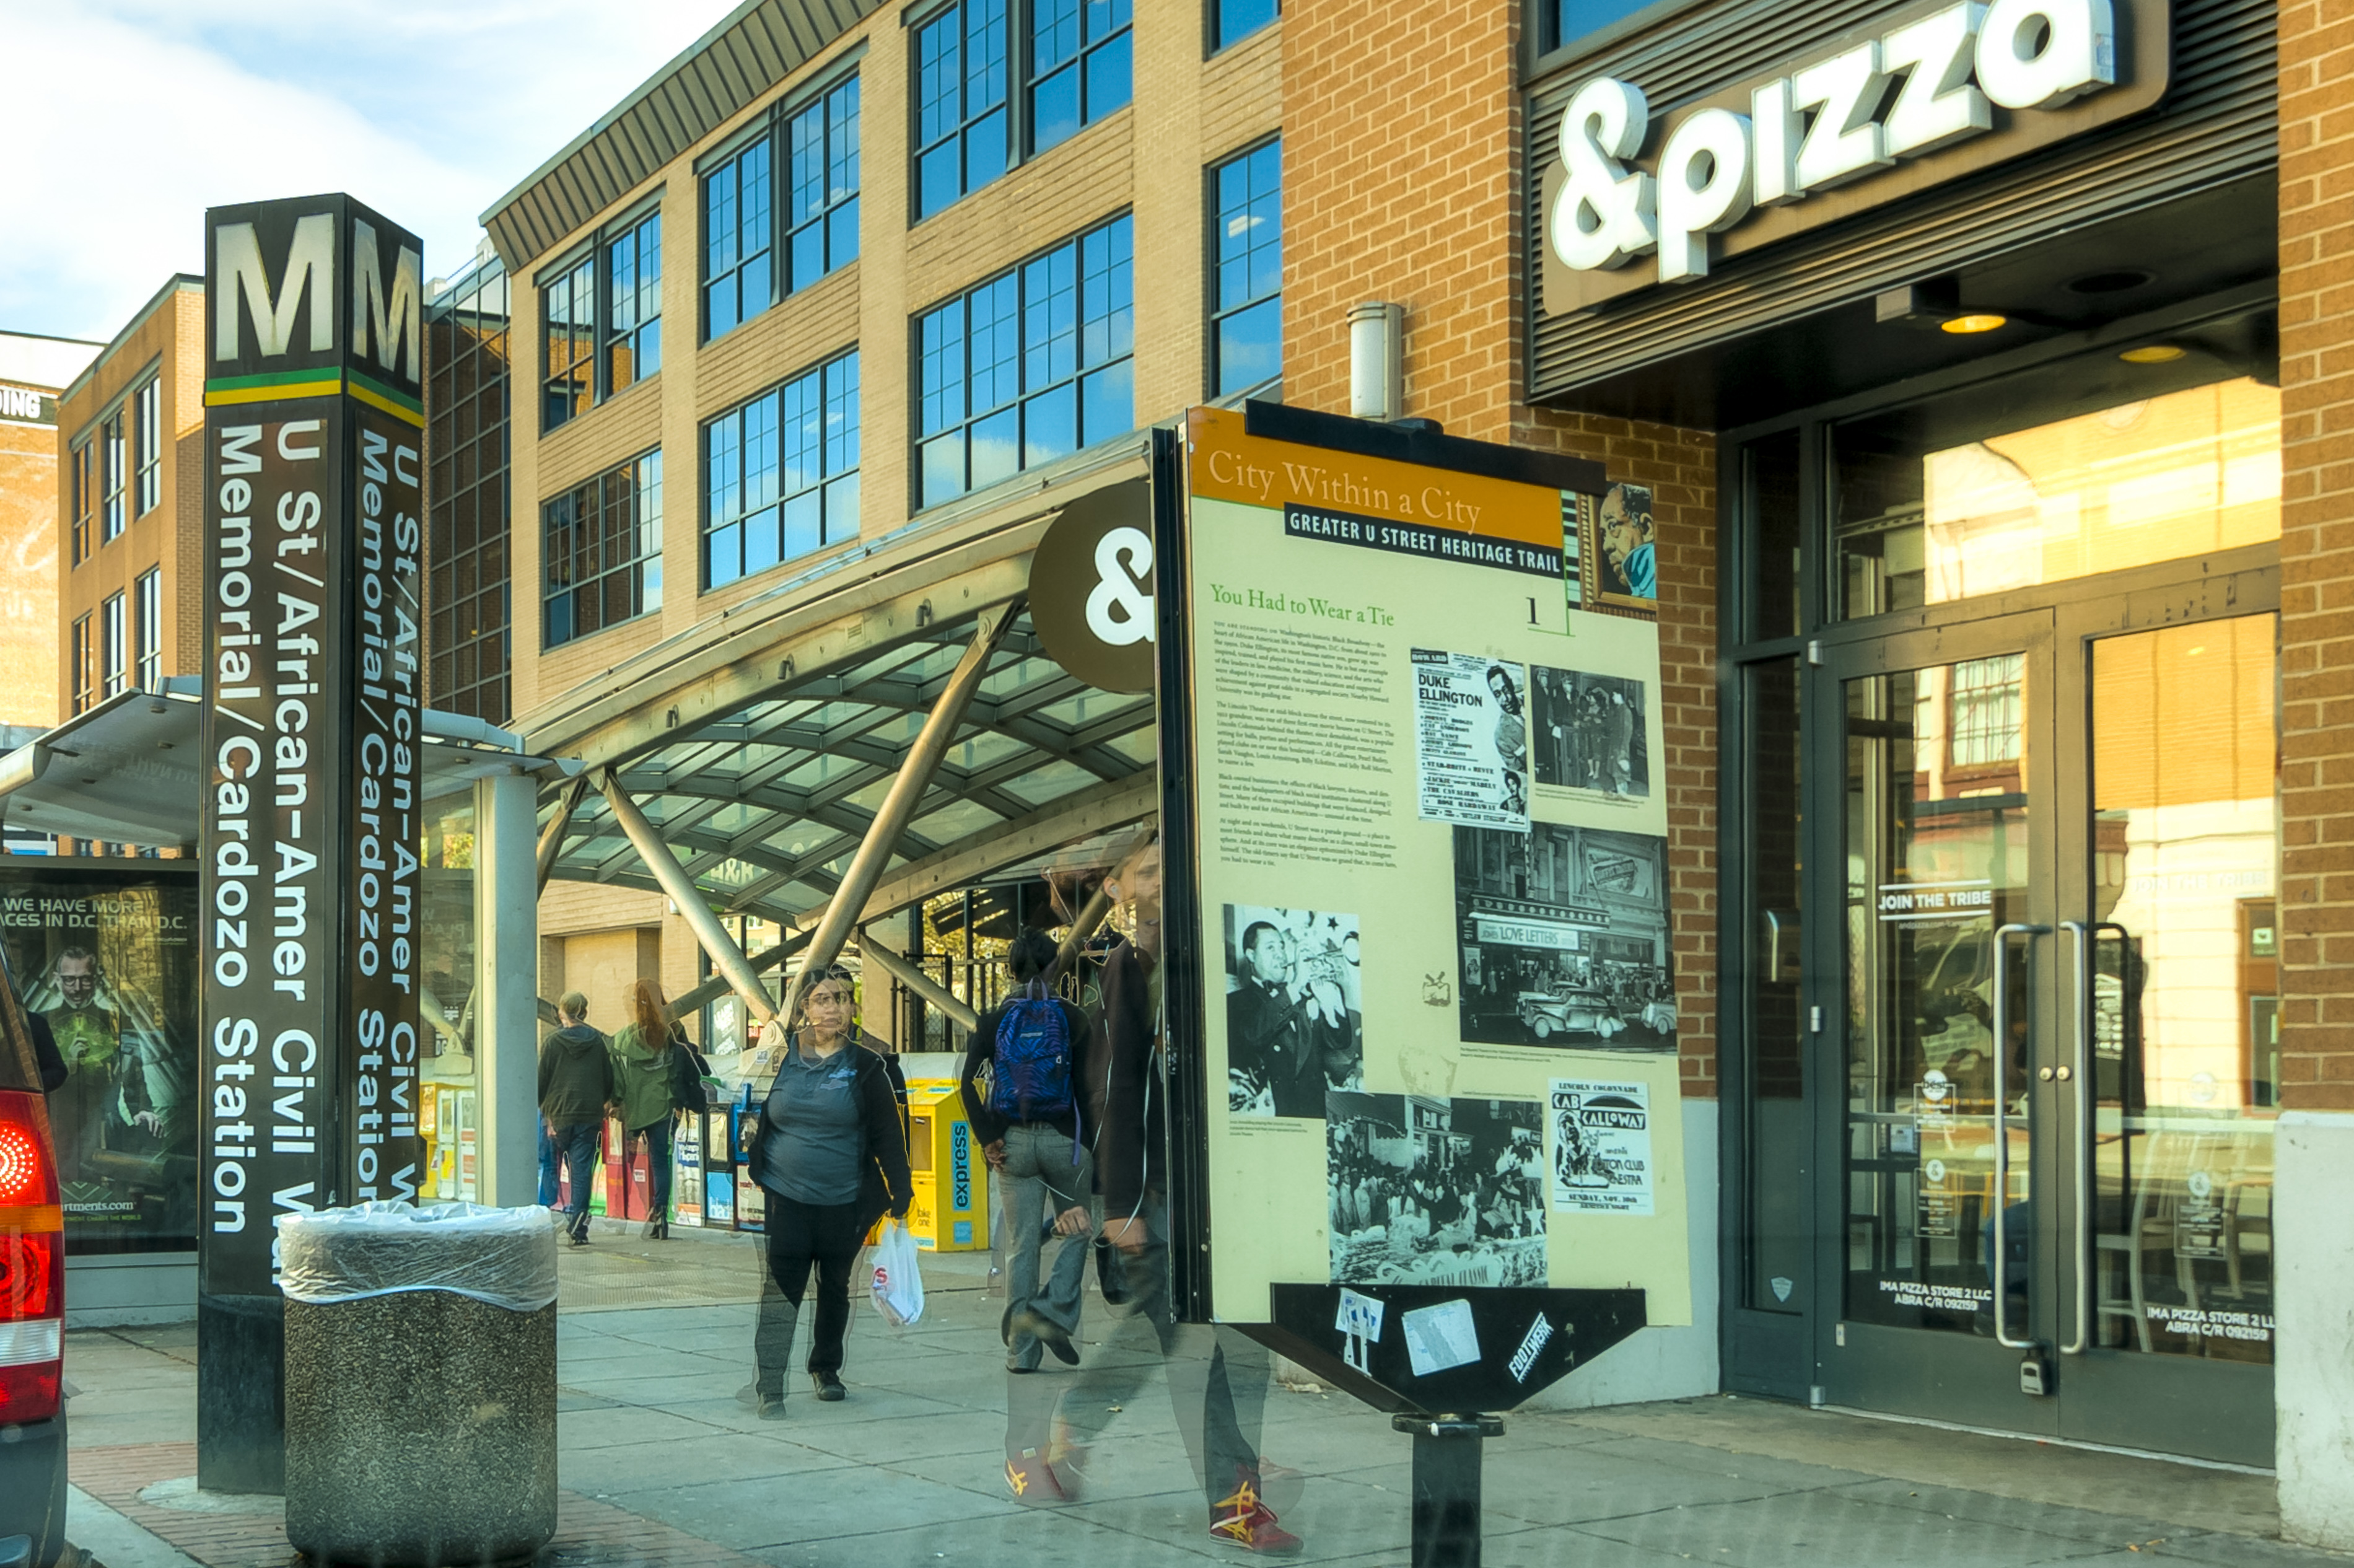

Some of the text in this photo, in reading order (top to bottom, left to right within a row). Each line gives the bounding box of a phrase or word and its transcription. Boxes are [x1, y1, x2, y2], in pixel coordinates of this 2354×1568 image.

[216, 212, 335, 362] M
[352, 217, 421, 385] M
[0, 390, 41, 419] ING
[278, 419, 320, 461] U
[394, 444, 419, 489] U
[1208, 450, 1481, 535] City Within a City
[1290, 512, 1560, 572] GREATER U STREET HERITAGE TRAIL
[1210, 583, 1394, 627] You Had to Wear a Tie
[1418, 673, 1451, 689] DUKE
[358, 428, 388, 977] Memorial/Cardozo
[1419, 688, 1483, 707] ELLINGTON
[213, 424, 265, 1233] Memorial/Cardozo Station
[4, 898, 144, 914] WE HAVE MORE
[1878, 890, 1992, 910] JOIN THE TRIBE
[46, 914, 63, 927] IN
[68, 914, 100, 928] D.C.
[106, 914, 151, 929] THAN
[159, 916, 188, 929] D.C.
[271, 1028, 317, 1154] Civil
[390, 1021, 416, 1138] Civil
[1554, 1093, 1579, 1108] CAB
[1582, 1111, 1644, 1128] CALLOWAY
[955, 1124, 970, 1208] express
[1624, 1160, 1645, 1171] CLUB
[1879, 1281, 1993, 1300] IMA PIZZA STORE 2 LLC
[1894, 1293, 1979, 1311] ABRA C/R 092159
[2146, 1307, 2276, 1328] IMA PIZZA STORE 2 LL
[2164, 1320, 2270, 1342] ABRA C/R 092159
